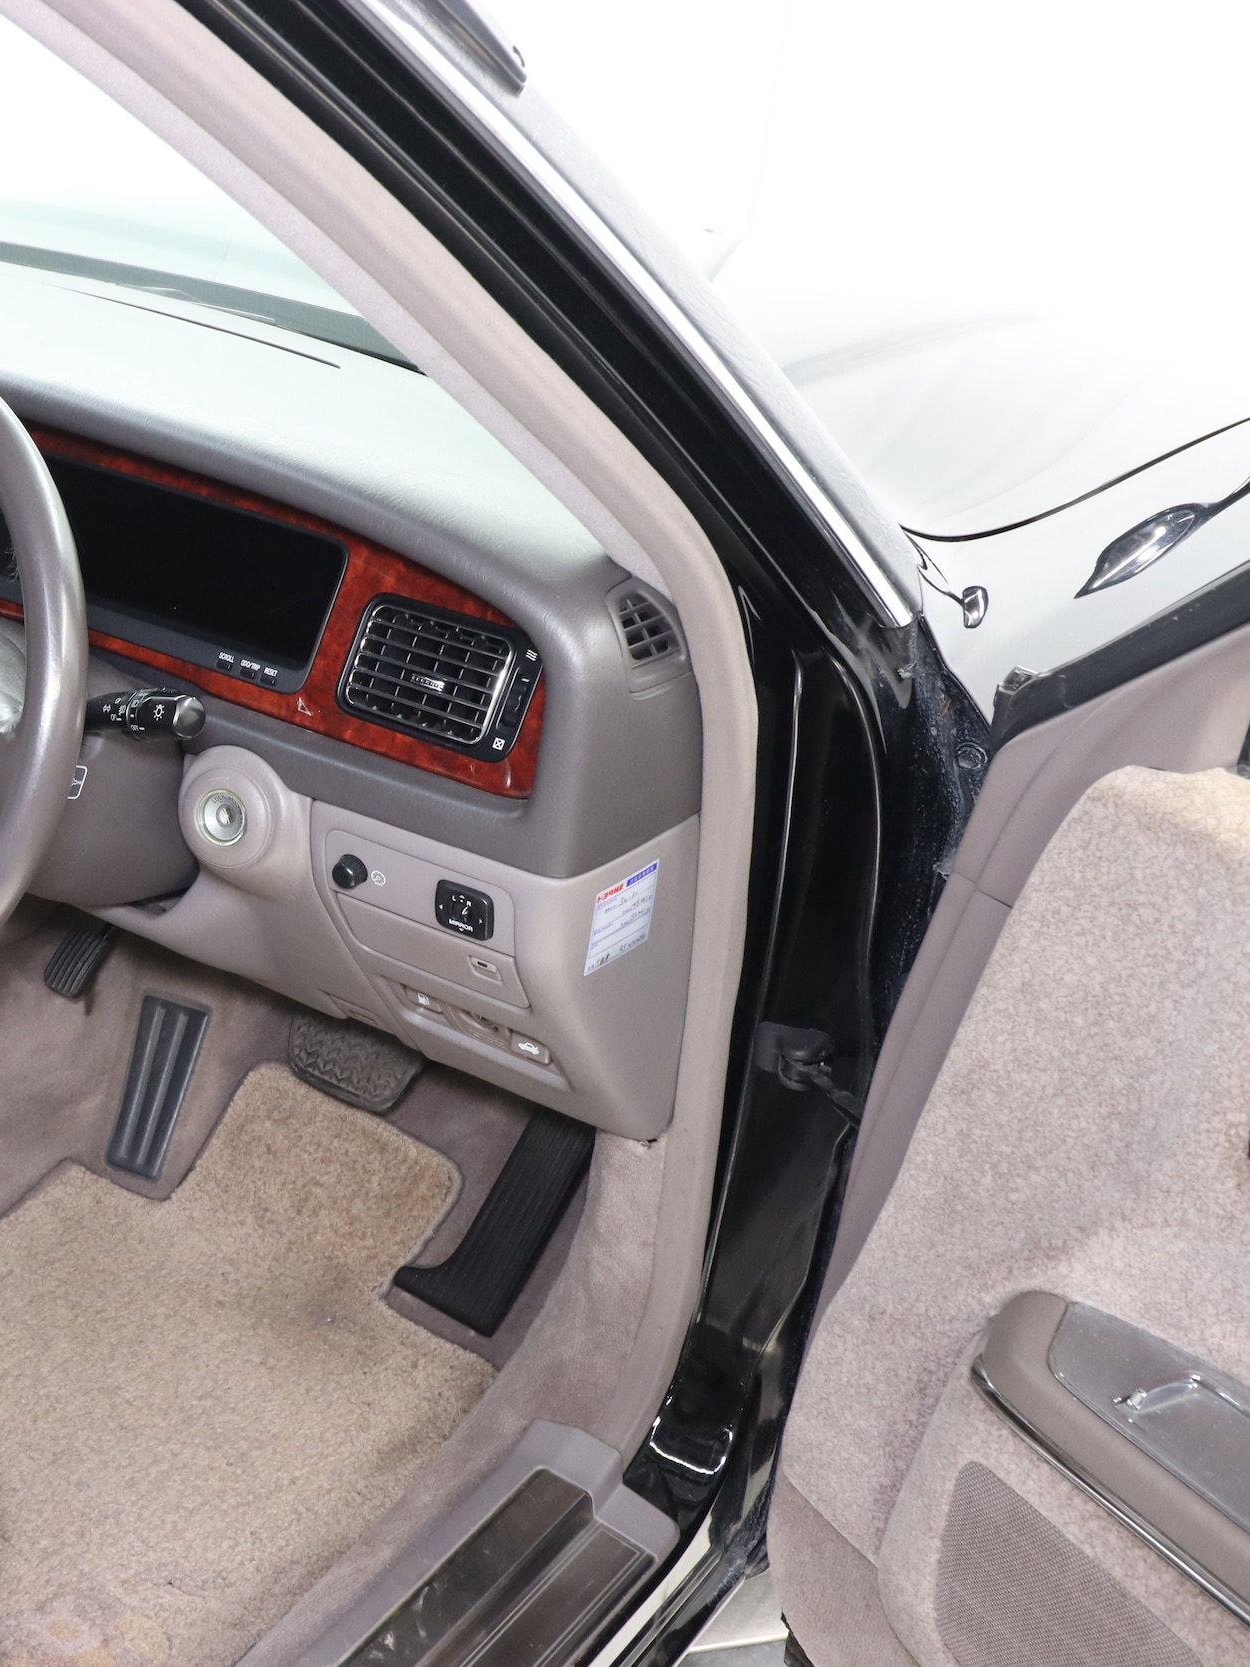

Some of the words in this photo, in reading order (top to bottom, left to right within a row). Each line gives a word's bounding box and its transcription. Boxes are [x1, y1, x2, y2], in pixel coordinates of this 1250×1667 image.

[218, 651, 235, 663] SCROLL
[240, 659, 261, 671] ODO/TRIP
[263, 666, 279, 677] RESET
[448, 918, 474, 933] MIRROR
